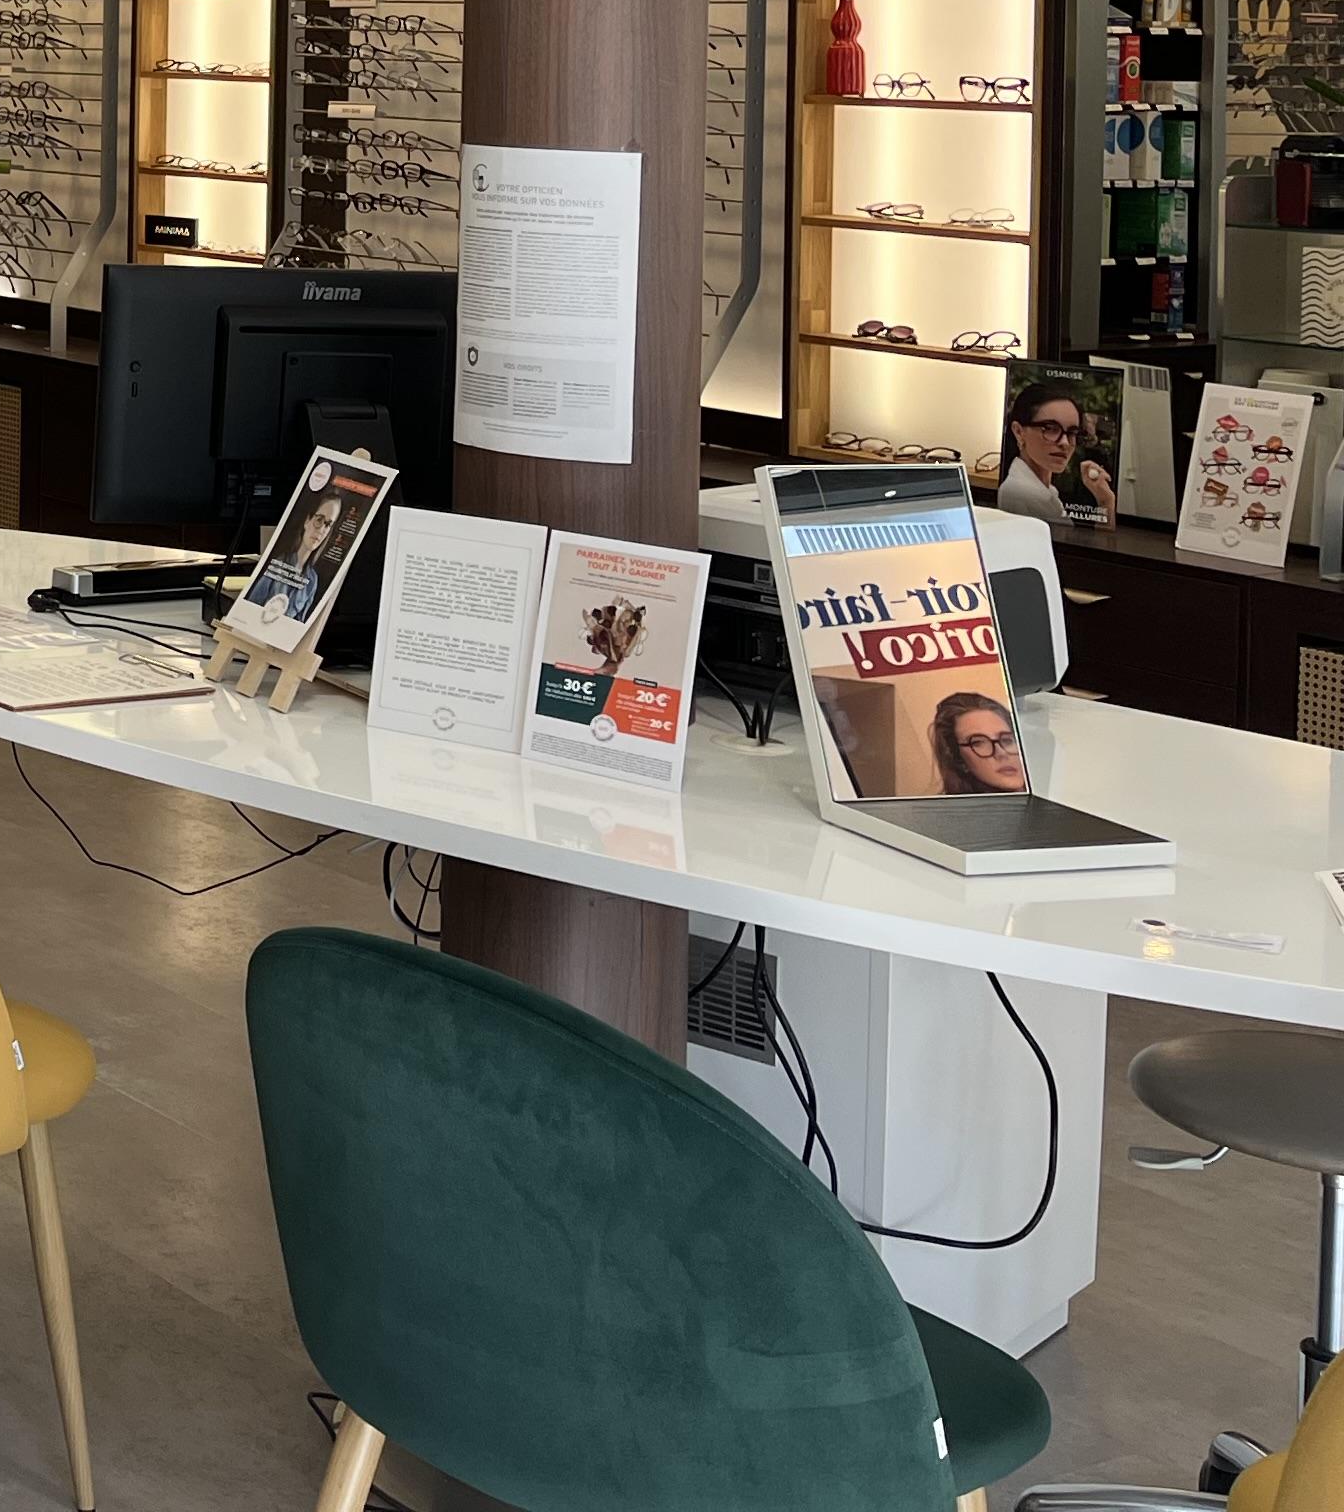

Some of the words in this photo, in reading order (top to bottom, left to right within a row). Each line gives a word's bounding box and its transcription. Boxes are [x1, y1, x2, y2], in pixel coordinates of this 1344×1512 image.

[496, 183, 521, 193] VOTRE
[522, 185, 564, 195] OPTICIEN
[487, 194, 518, 205] INFORME
[520, 196, 537, 205] SUR
[539, 198, 557, 207] VOS
[558, 197, 605, 209] DONNÉES
[302, 280, 362, 301] iiyama
[1069, 511, 1109, 524] ALLURES
[587, 561, 610, 571] TOUT
[628, 568, 666, 581] GAGNER
[628, 558, 654, 570] VOUS
[654, 563, 681, 574] AVEZ
